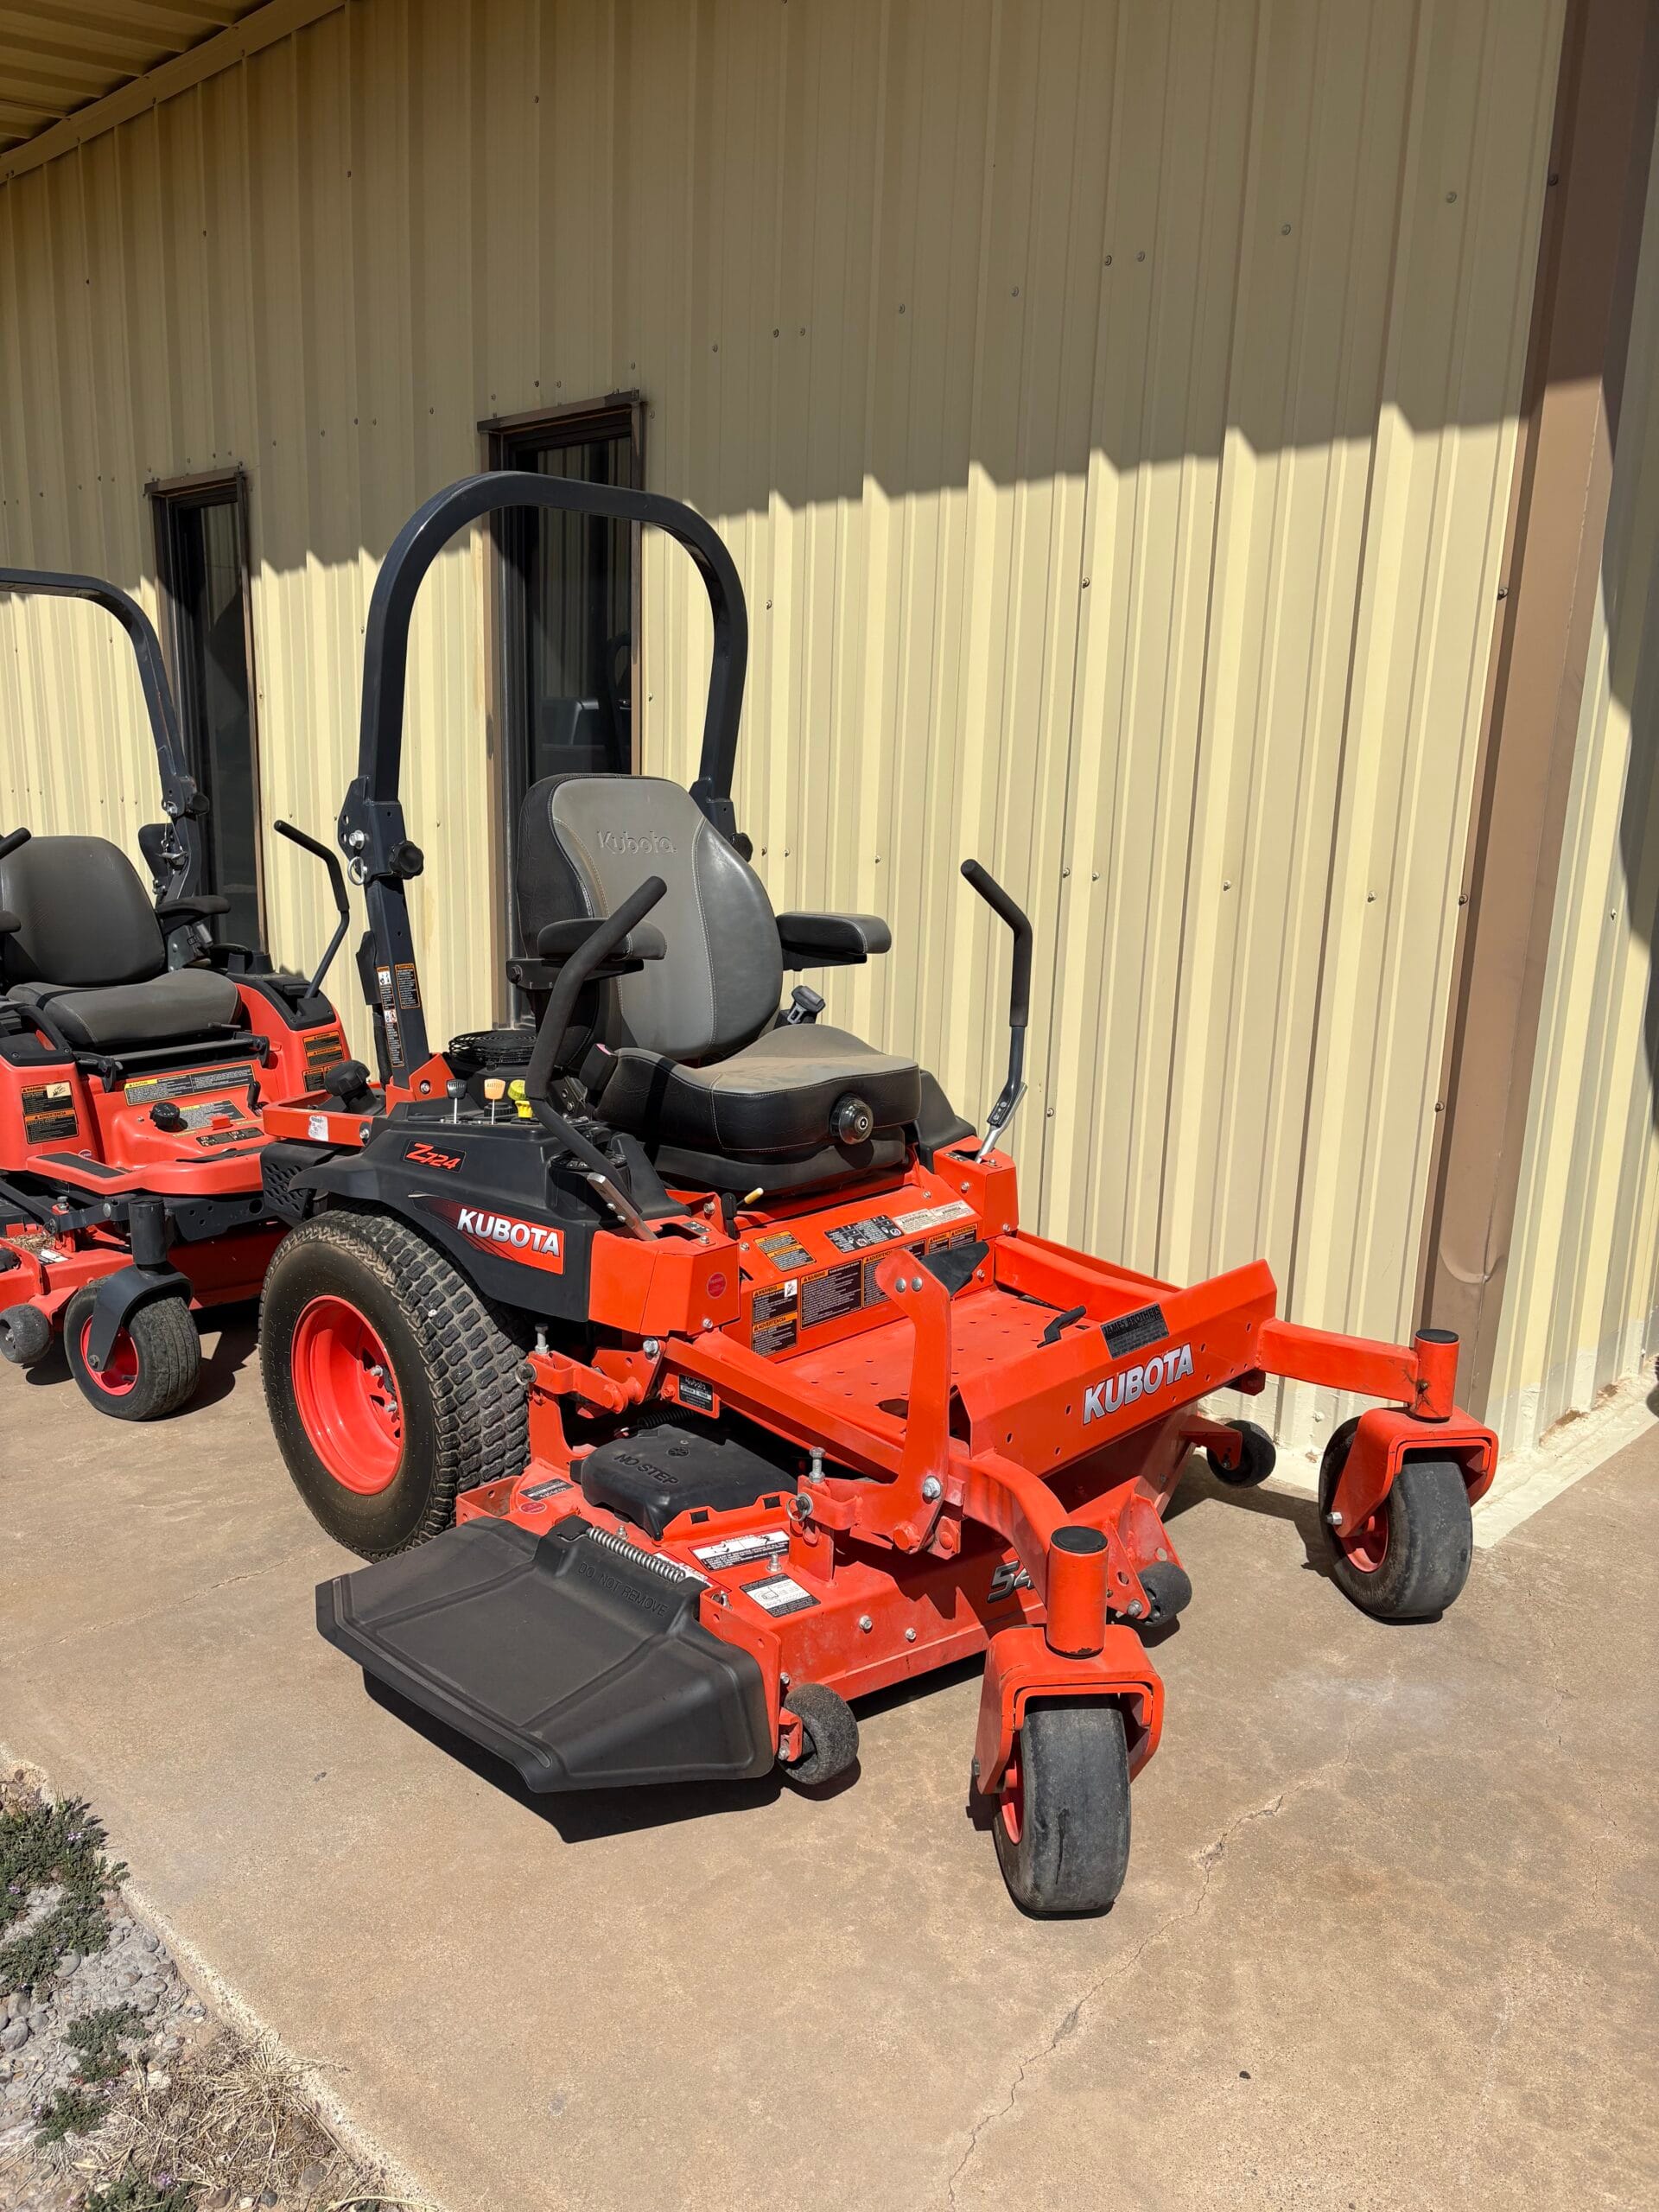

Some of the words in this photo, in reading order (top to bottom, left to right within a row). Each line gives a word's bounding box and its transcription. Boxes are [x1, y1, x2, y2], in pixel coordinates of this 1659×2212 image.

[597, 830, 678, 855] Kubota
[405, 1142, 461, 1170] Z724
[457, 1208, 561, 1256] KUBOTA
[1126, 1305, 1161, 1326] BROTHERS
[1083, 1342, 1195, 1425] KUBOTA
[614, 1453, 639, 1466] NO
[637, 1464, 679, 1484] STEP
[578, 1561, 595, 1579] DO
[598, 1573, 622, 1592] NOT
[621, 1586, 669, 1618] REMOVE
